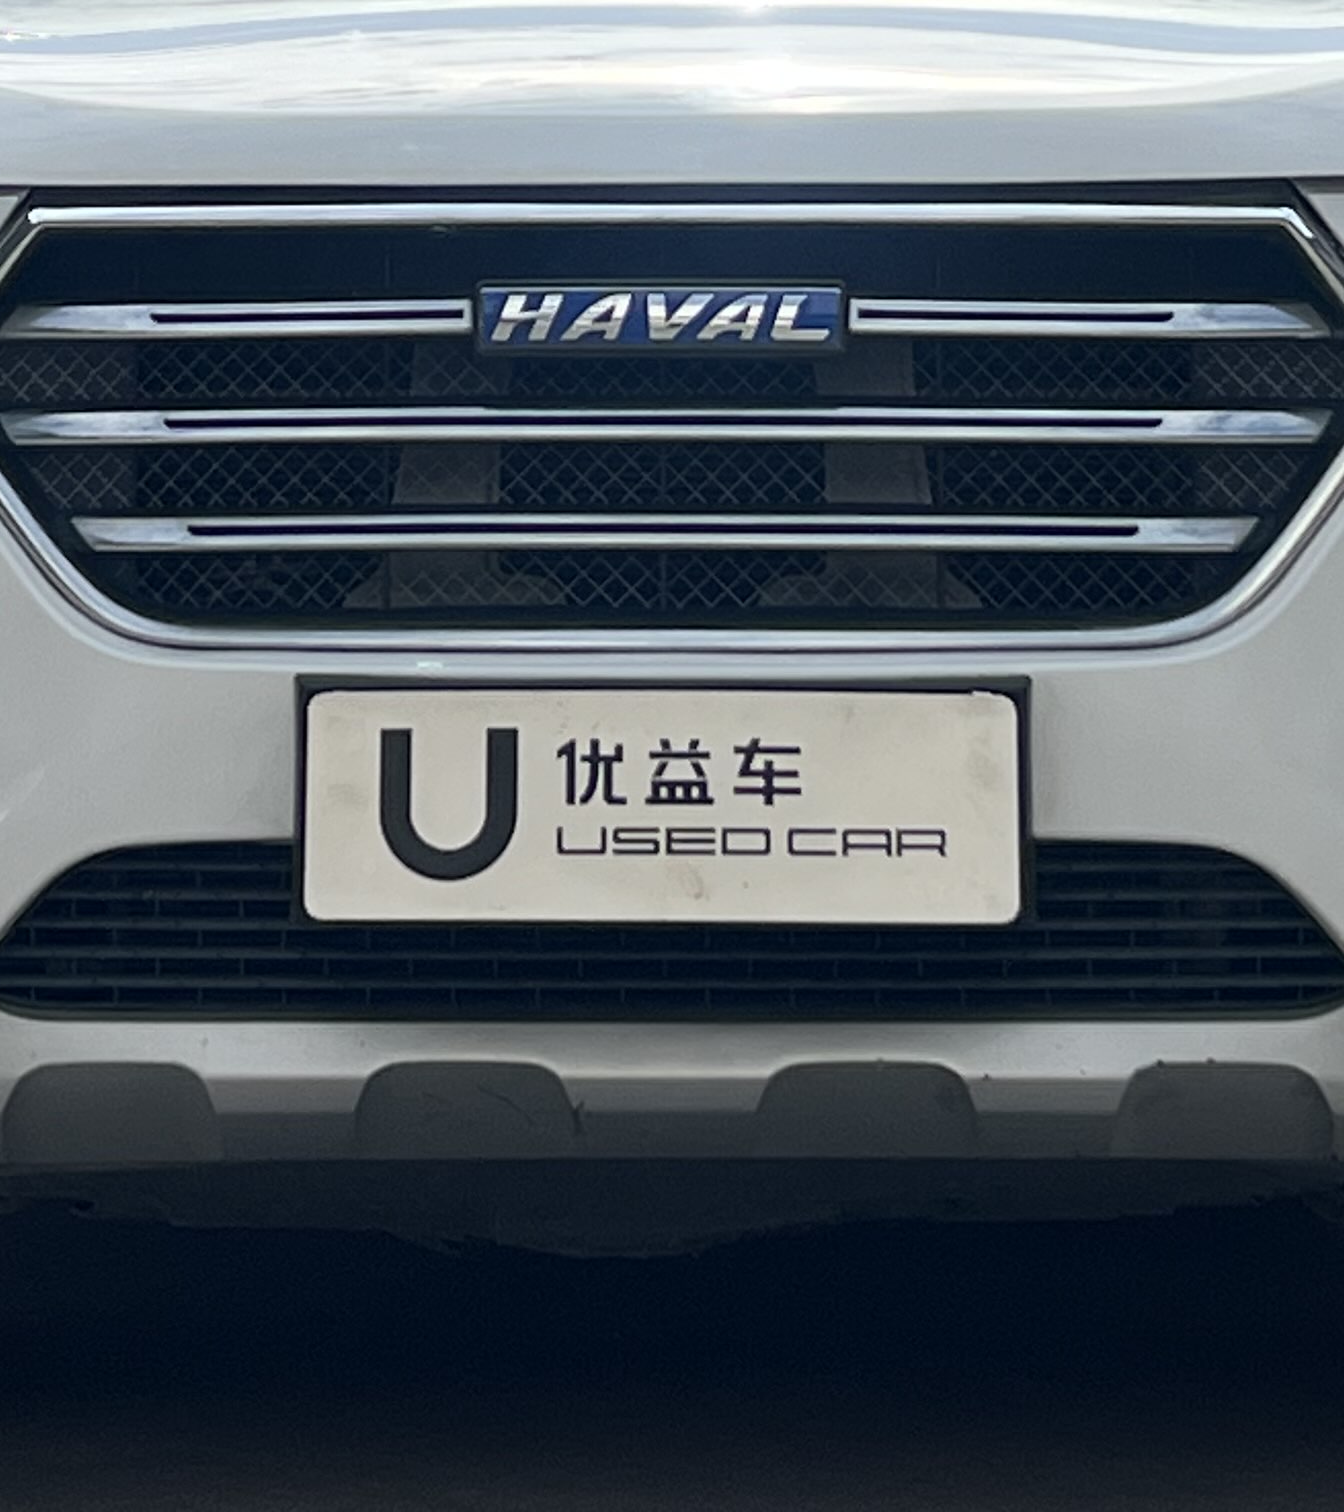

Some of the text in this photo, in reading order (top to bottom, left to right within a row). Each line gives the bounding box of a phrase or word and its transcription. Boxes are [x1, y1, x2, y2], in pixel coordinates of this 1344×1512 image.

[490, 292, 831, 342] HAVAL
[556, 737, 802, 806] 优益车
[379, 727, 519, 881] U
[556, 826, 948, 858] USED CAR
